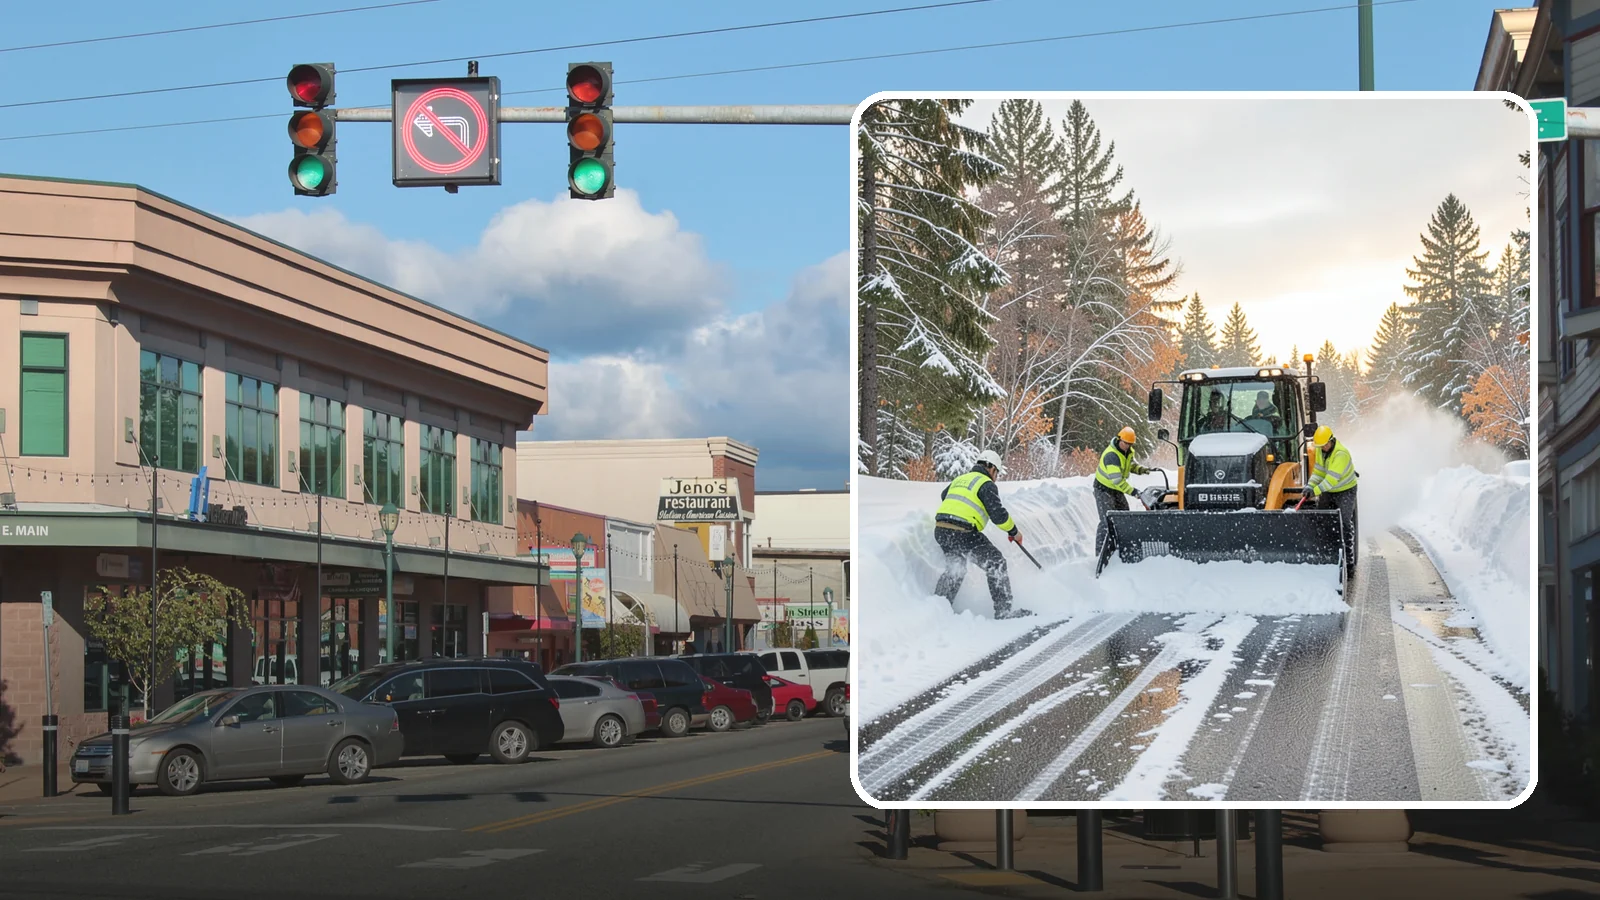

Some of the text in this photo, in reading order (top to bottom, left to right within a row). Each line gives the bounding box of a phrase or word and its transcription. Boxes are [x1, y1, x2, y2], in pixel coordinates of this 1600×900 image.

[670, 480, 728, 494] Jeno's
[665, 497, 731, 509] restaurant
[658, 510, 681, 519] Italian
[686, 510, 714, 519] American
[715, 509, 738, 519] Cuisine
[2, 525, 49, 536] E. MAIN
[797, 607, 829, 617] Street
